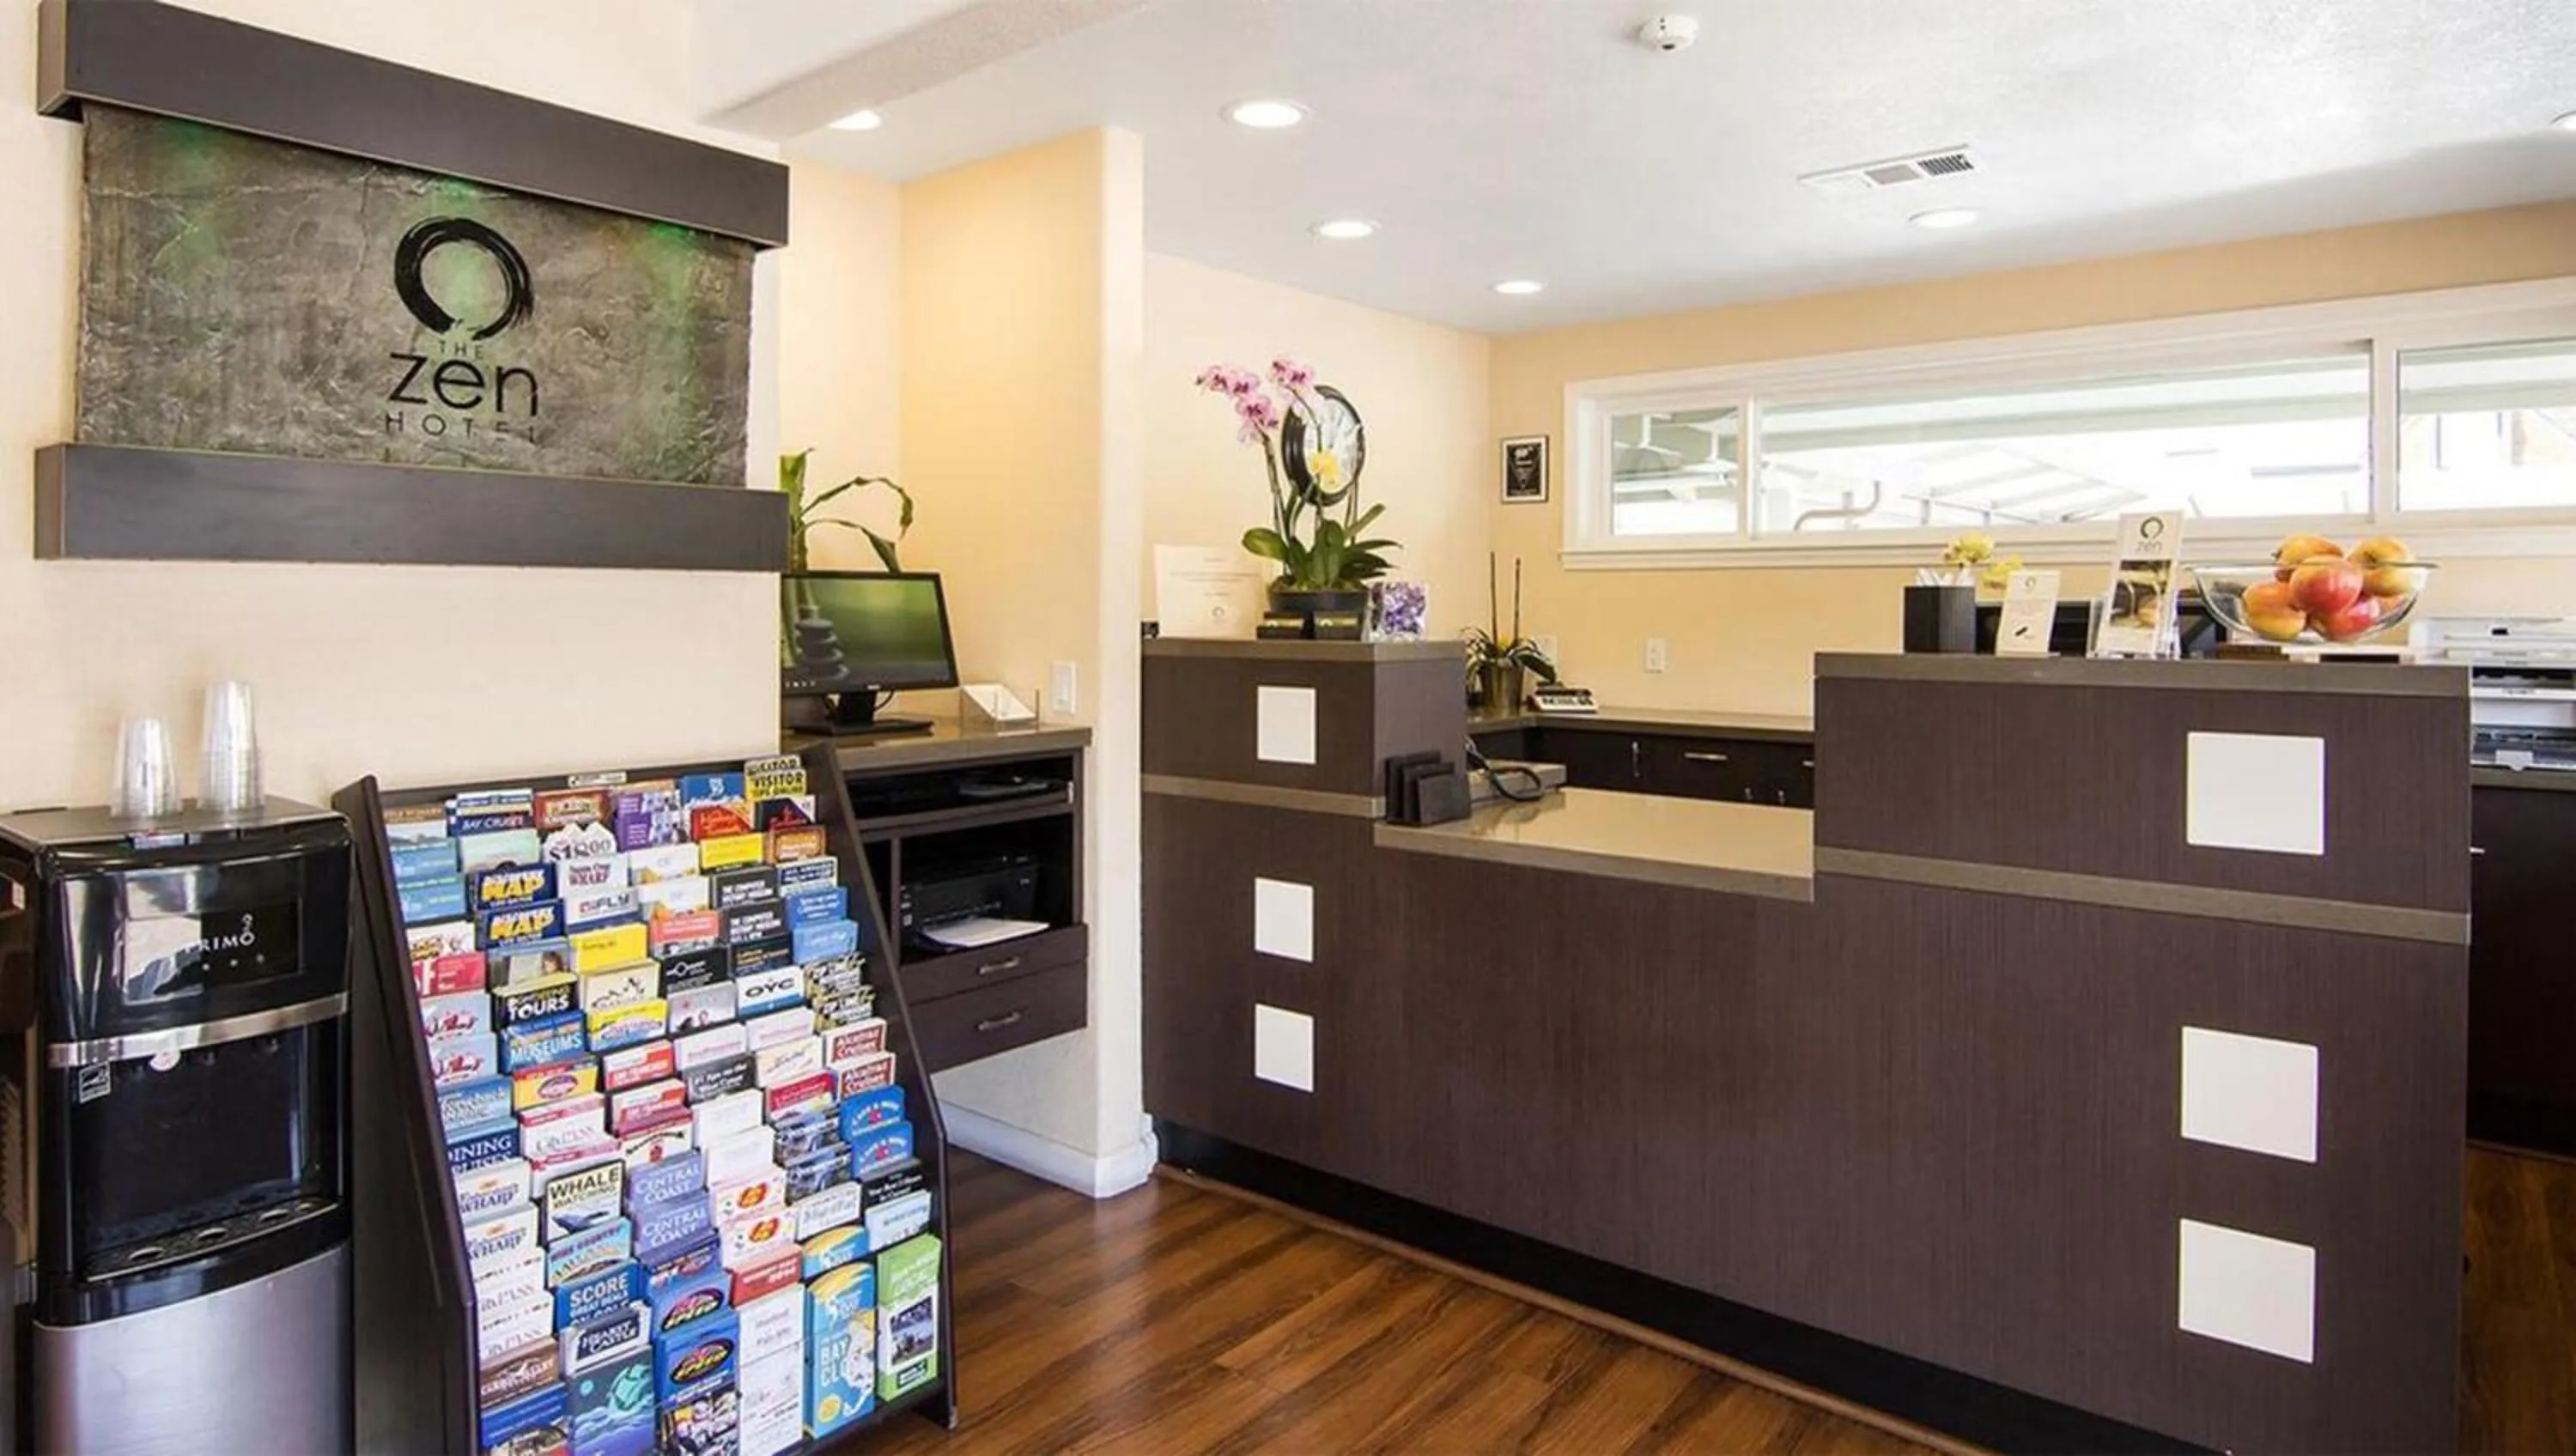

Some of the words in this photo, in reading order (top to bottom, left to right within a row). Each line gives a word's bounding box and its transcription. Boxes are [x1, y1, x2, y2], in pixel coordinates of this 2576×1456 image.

[438, 340, 485, 359] THE
[389, 352, 539, 417] zen
[385, 410, 538, 444] HOTEL
[550, 1168, 619, 1199] WHALE
[636, 1163, 700, 1194] CENTRAL
[643, 1207, 708, 1237] CENTRAL
[569, 1271, 629, 1307] SCORE
